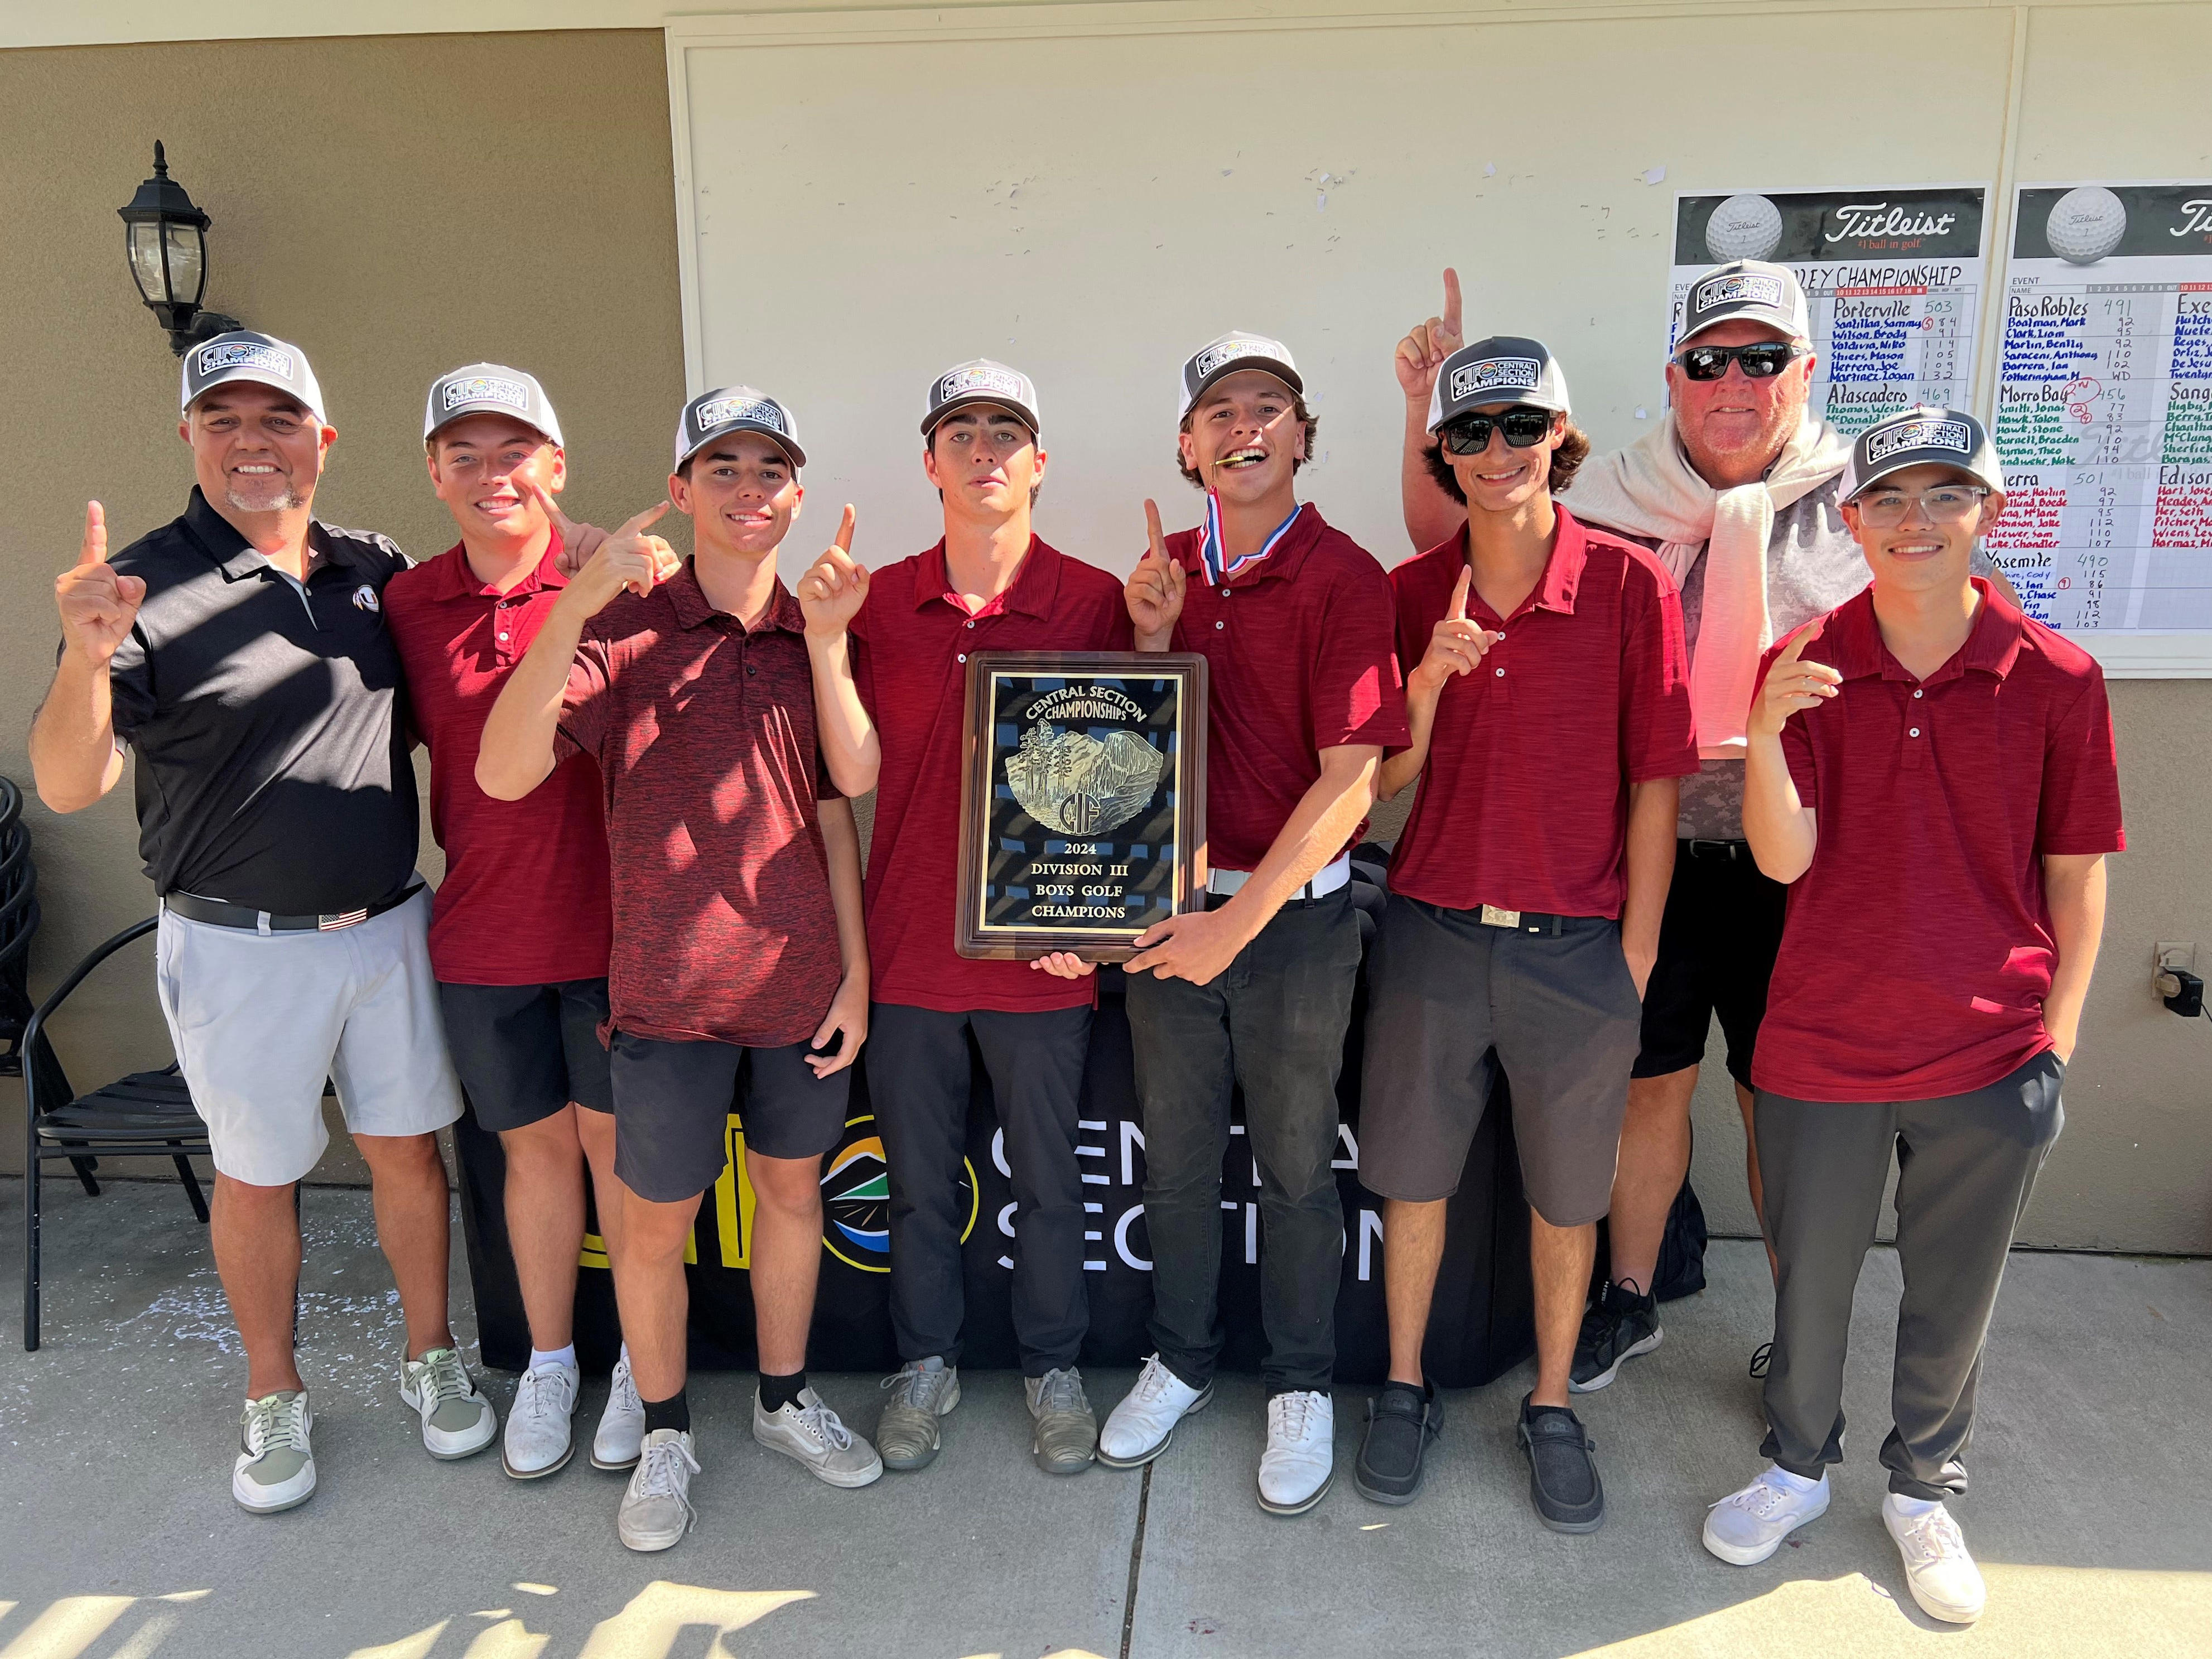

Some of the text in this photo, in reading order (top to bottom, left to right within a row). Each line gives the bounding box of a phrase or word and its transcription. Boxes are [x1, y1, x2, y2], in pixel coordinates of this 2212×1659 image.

[1726, 221, 1760, 233] Titleist
[1824, 202, 1955, 243] Titleist
[2069, 214, 2104, 225] Titleist
[1869, 238, 1887, 249] ball
[1889, 239, 1899, 249] in
[1837, 265, 1962, 288] CHAMPIONSHIP
[1700, 280, 1726, 301] CIF
[1701, 290, 1779, 308] CHAMPIONS
[1834, 297, 1952, 318] Porterville 503
[2009, 296, 2131, 317] Paso Robles 491
[1497, 362, 1534, 371] CENTRAL
[1497, 369, 1534, 377] SECTION
[1453, 366, 1481, 388] CIF
[1456, 377, 1535, 397] CHAMPIONS
[1827, 383, 1950, 404] Atascadero 469
[2001, 384, 2040, 402] Morro
[2042, 384, 2069, 404] Bay
[1921, 423, 1963, 433] CENTRAL
[1922, 430, 1964, 440] SECTION
[1871, 428, 1902, 452] CIF
[1872, 437, 1965, 460] CHAMPIONS
[2074, 472, 2103, 485] 501
[1985, 550, 2108, 568] Yosemite 490
[1026, 686, 1147, 722] CENTRAL SECTION
[1045, 700, 1127, 721] CHAMPIONSHIPS
[1059, 792, 1101, 835] CIF
[1064, 843, 1097, 855] 2024
[1031, 864, 1129, 876] DIVISION III
[1035, 884, 1122, 897] BOYS GOLF
[1032, 905, 1125, 919] CHAMPIONS
